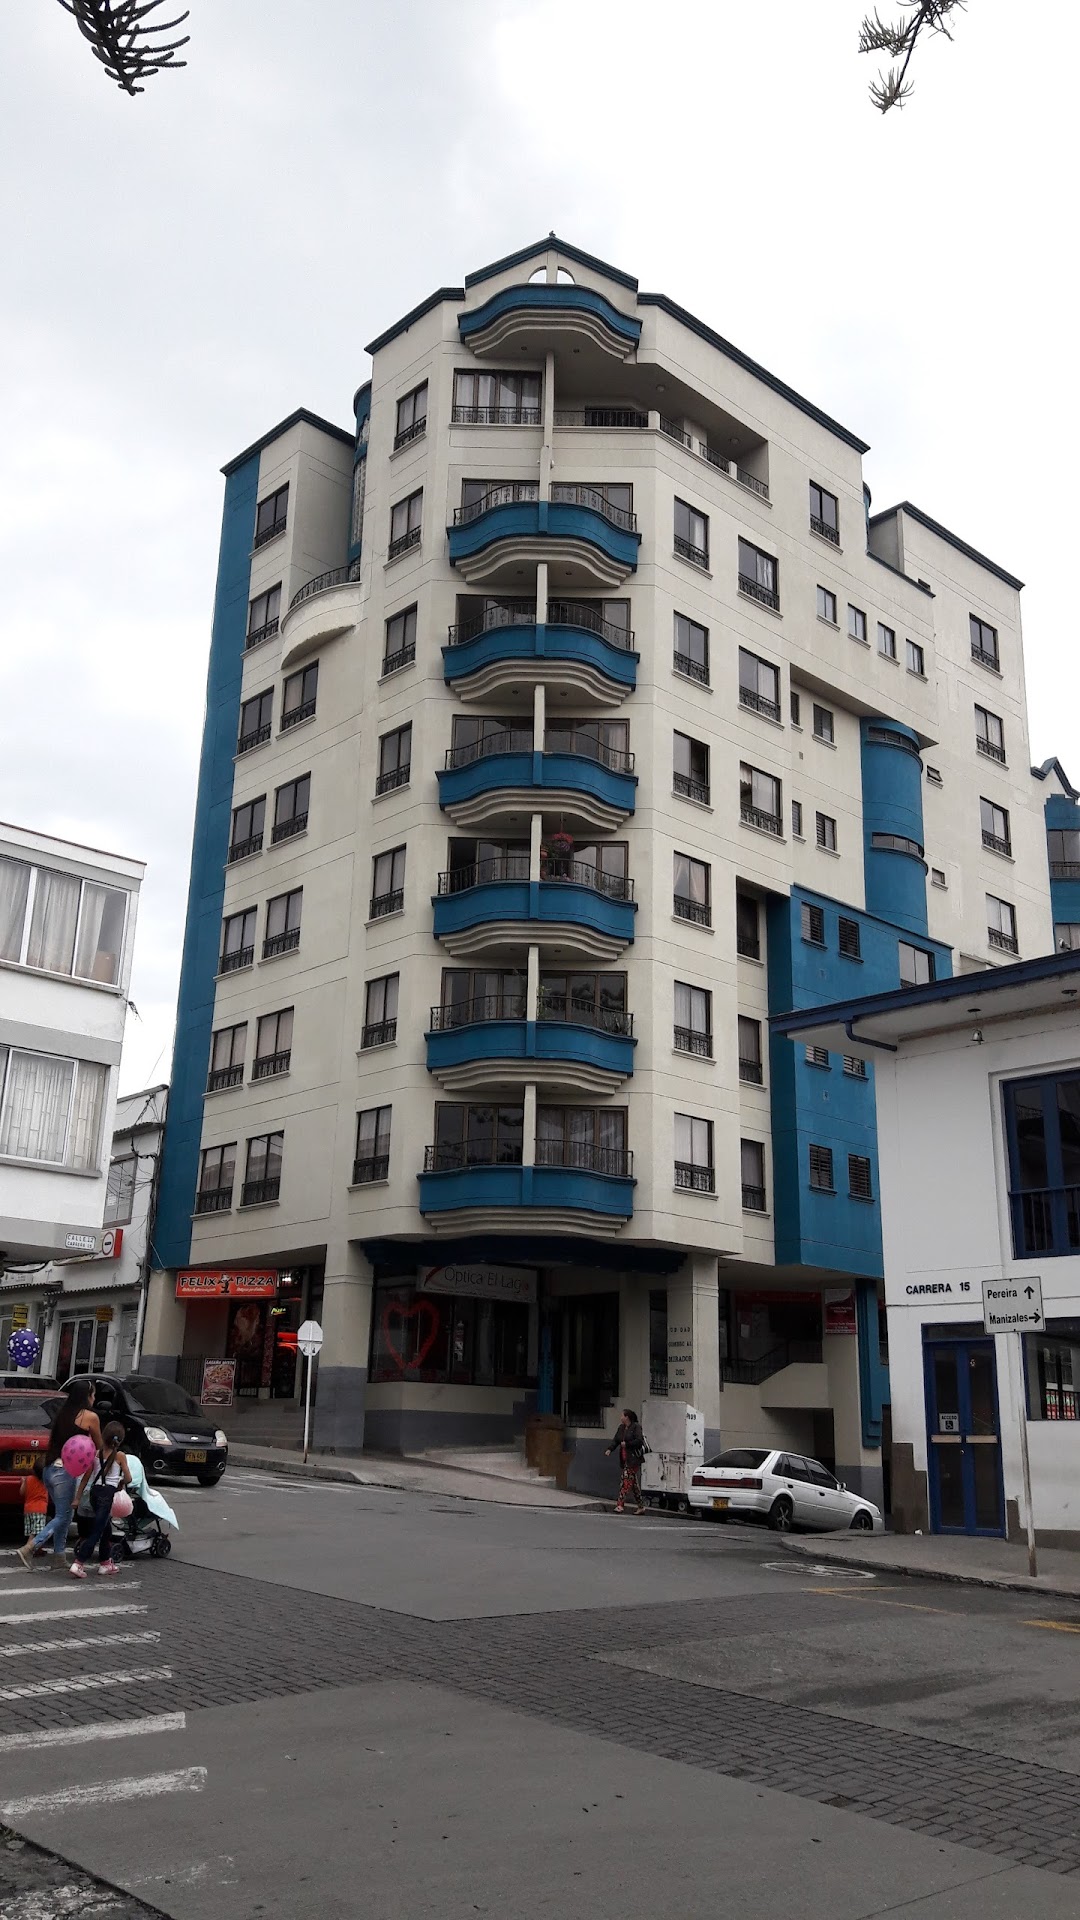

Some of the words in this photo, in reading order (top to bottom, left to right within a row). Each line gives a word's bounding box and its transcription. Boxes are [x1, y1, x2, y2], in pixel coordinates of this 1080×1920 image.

[181, 1277, 216, 1286] FELIX
[236, 1276, 275, 1287] PIZZA
[444, 1266, 483, 1286] Optica
[487, 1272, 498, 1286] El
[905, 1282, 952, 1295] CARRERA
[960, 1282, 971, 1291] 15
[987, 1288, 1018, 1299] Pereira
[988, 1313, 1029, 1325] Manizales
